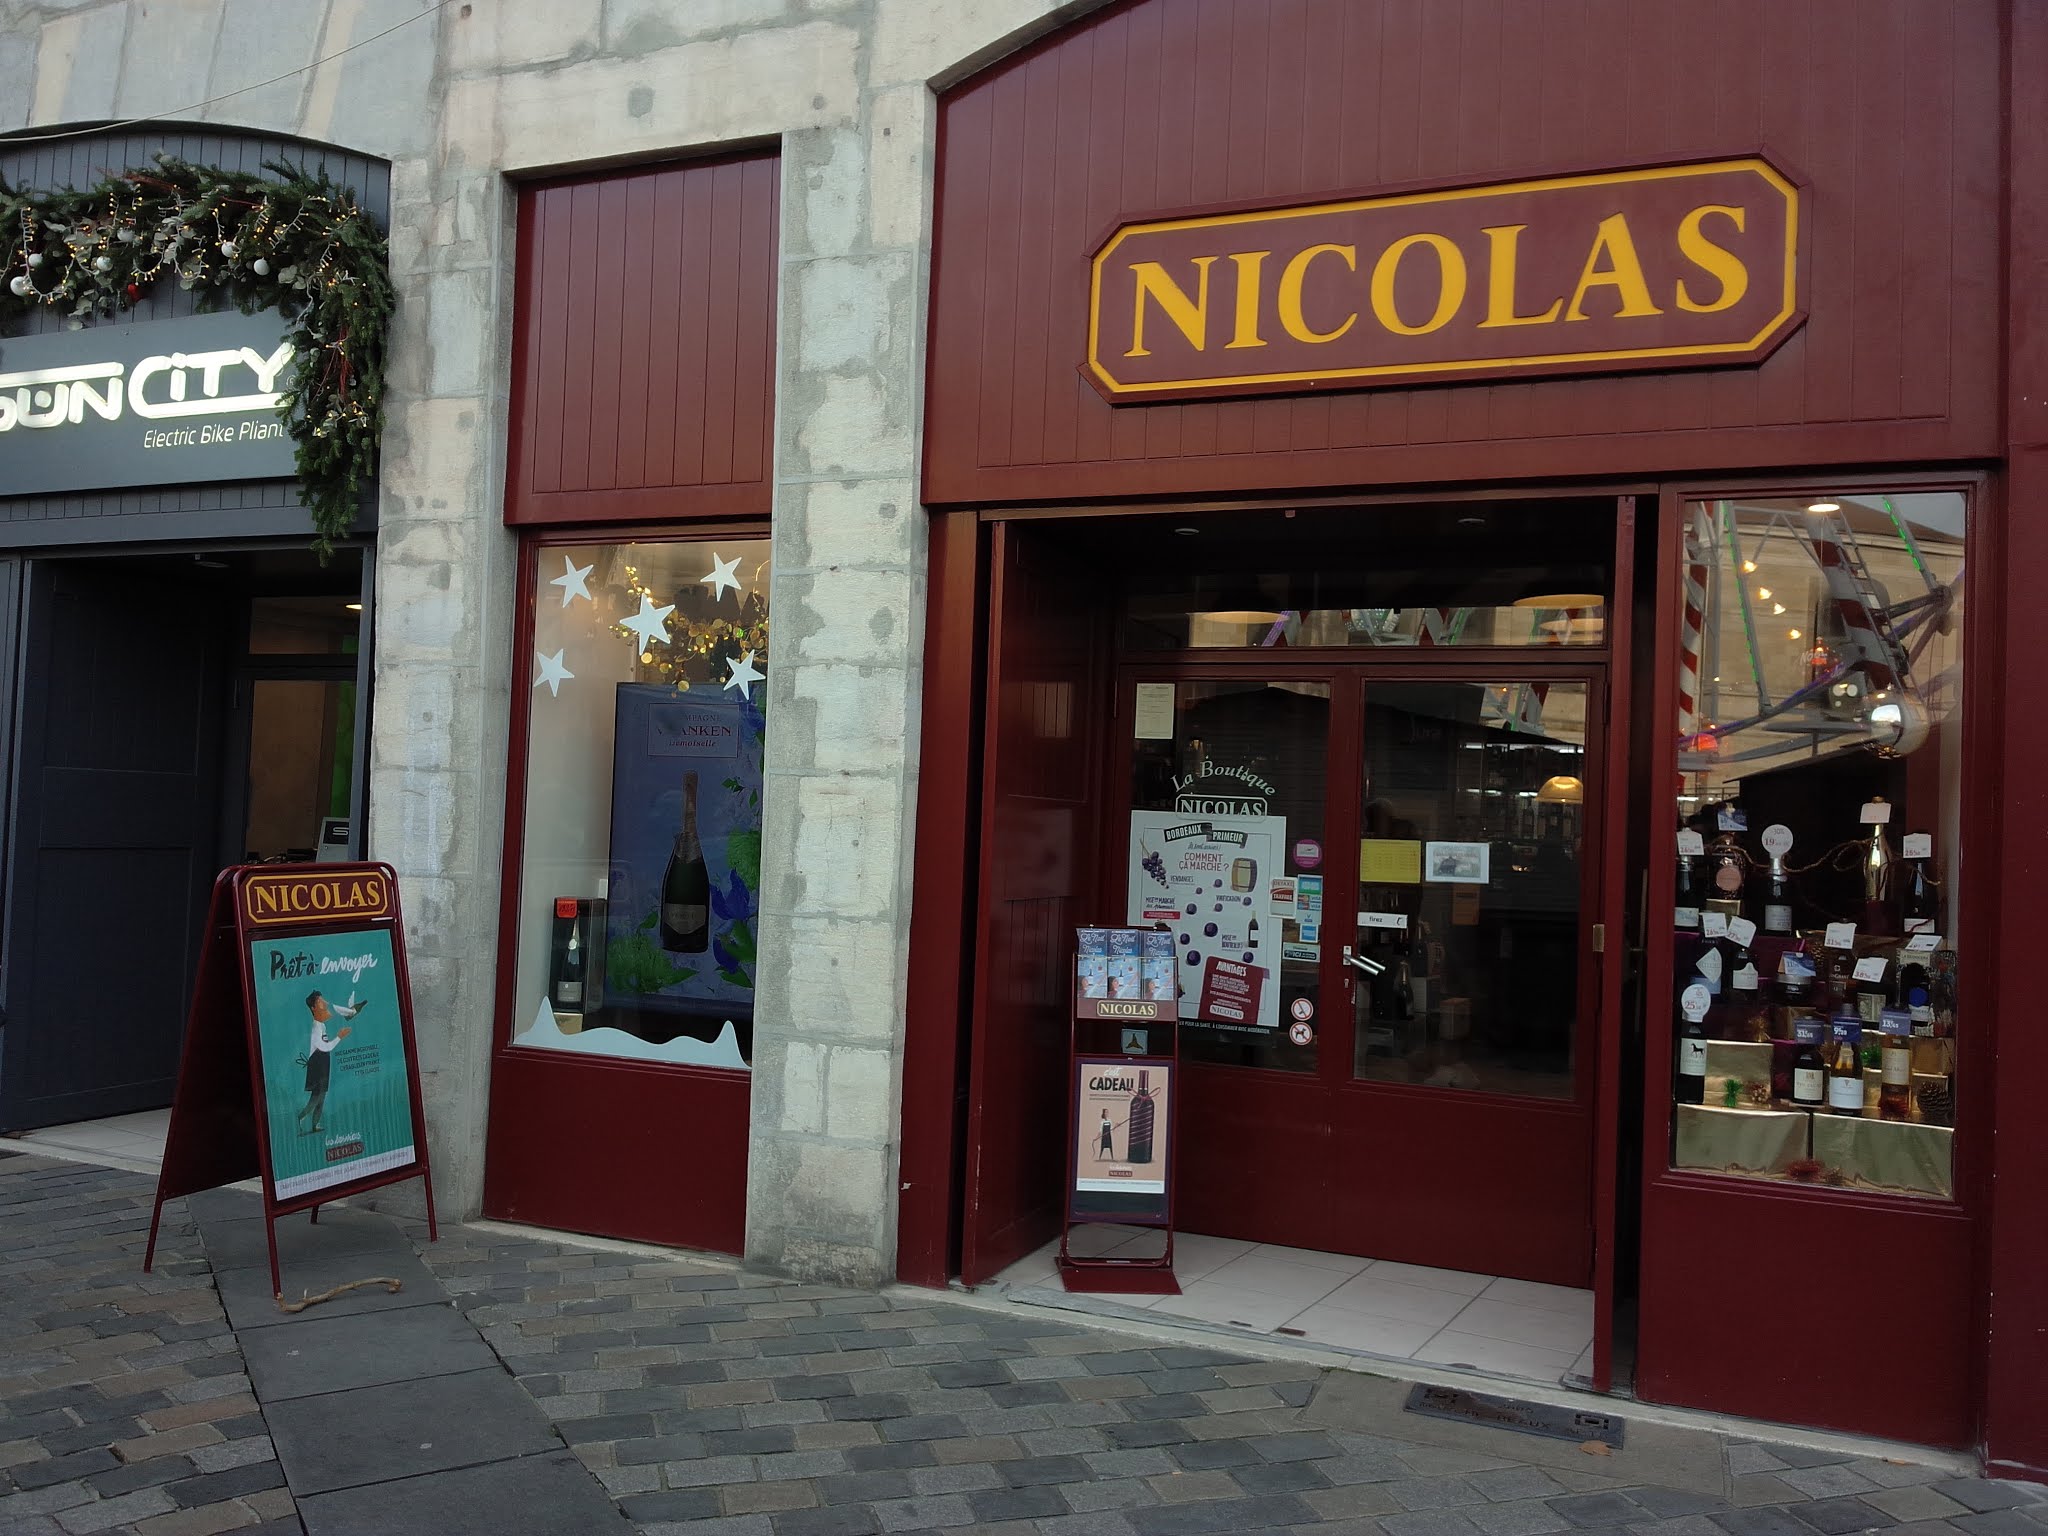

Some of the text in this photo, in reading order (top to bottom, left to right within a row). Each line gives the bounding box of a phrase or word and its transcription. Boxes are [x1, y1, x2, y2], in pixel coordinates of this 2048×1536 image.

[1123, 203, 1749, 357] NICOLAS
[143, 426, 197, 448] Electric
[200, 423, 234, 444] Bike
[1170, 773, 1194, 792] La
[1181, 799, 1262, 816] NICOLAS
[1165, 824, 1244, 843] BORDEAUX PRIMEUR
[1184, 852, 1224, 863] COMMENT
[1178, 861, 1188, 871] ÇA
[1189, 862, 1222, 872] MARCHE
[254, 880, 381, 914] NICOLAS
[1215, 960, 1248, 977] AVANTAGES
[1099, 1003, 1155, 1016] NICOLAS
[1211, 1005, 1242, 1018] NICOLAS
[1089, 1076, 1134, 1092] CADEAU
[327, 1143, 362, 1161] NICOLAS
